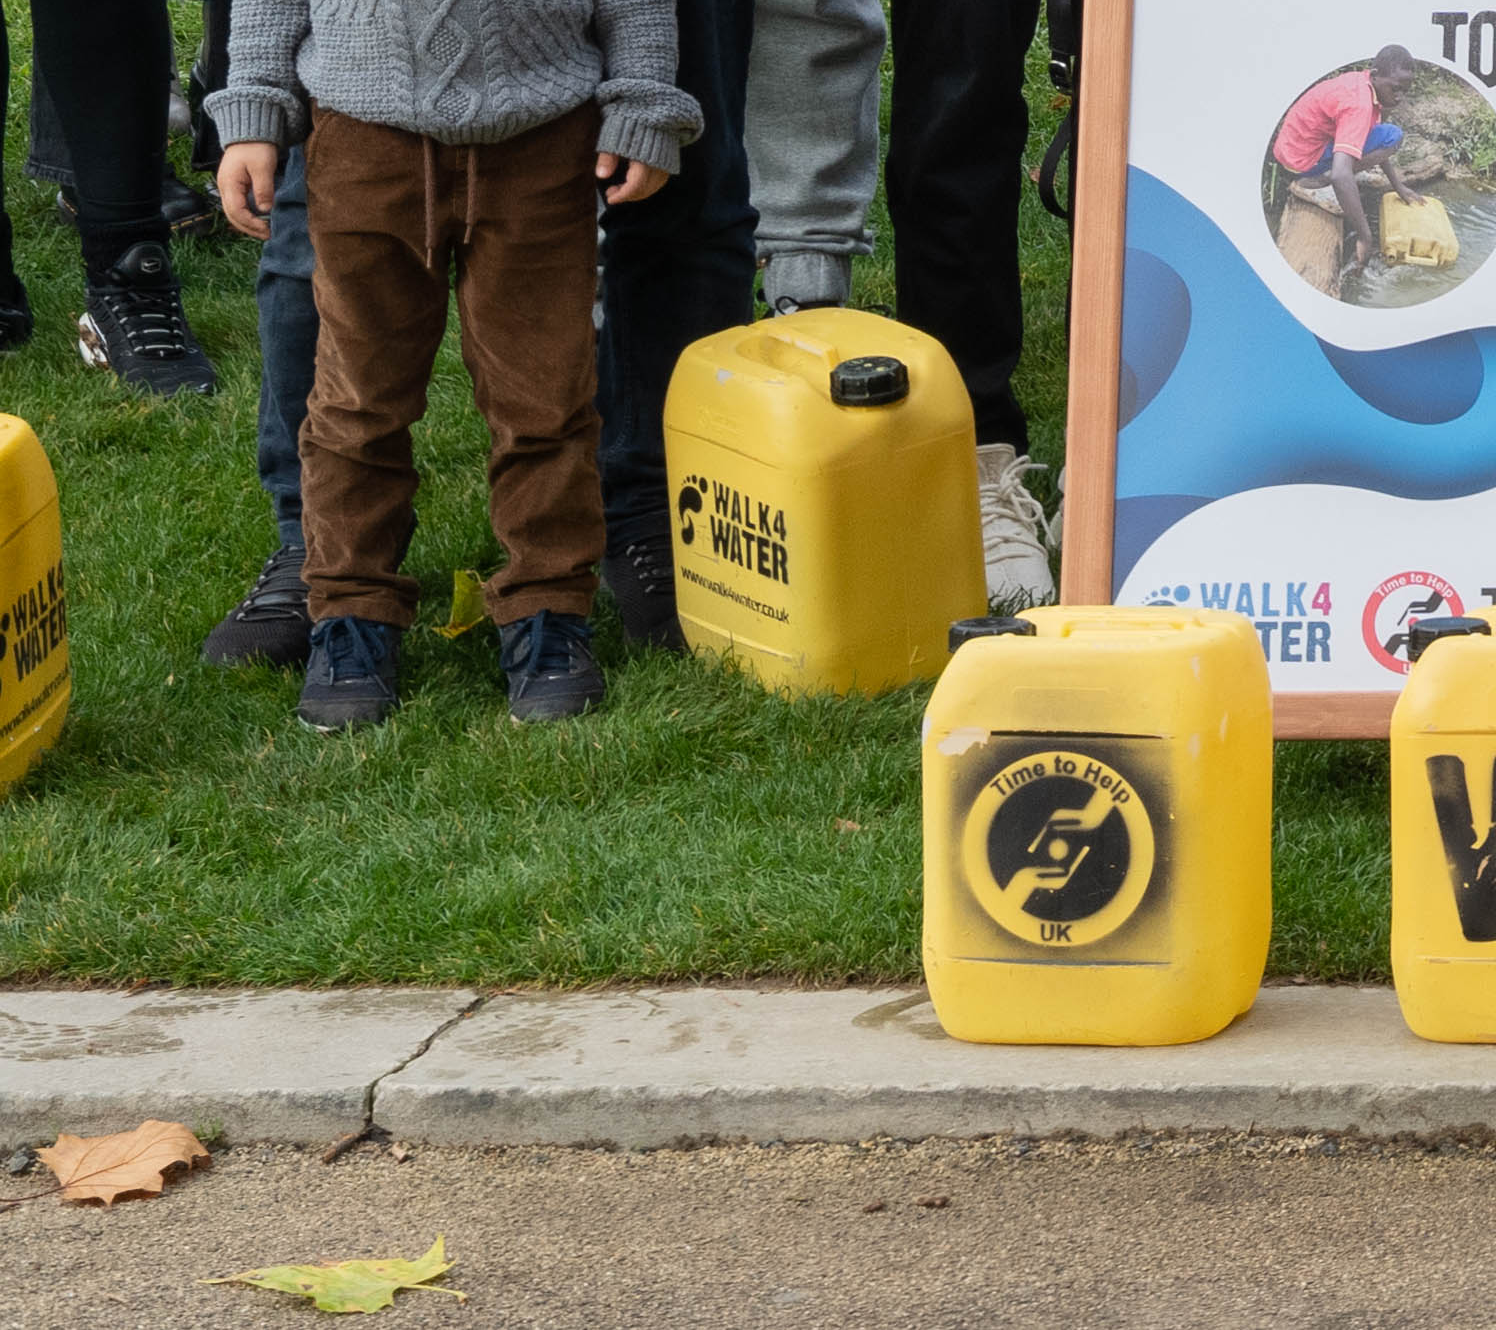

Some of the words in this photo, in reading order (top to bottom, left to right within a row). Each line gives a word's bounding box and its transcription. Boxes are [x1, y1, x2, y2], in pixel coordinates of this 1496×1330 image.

[713, 479, 787, 542] WALK4
[709, 513, 789, 585] WATER
[1200, 582, 1333, 618] WALK4
[1377, 576, 1410, 599] Time
[1409, 572, 1425, 584] to
[1424, 574, 1452, 598] Help
[1262, 621, 1333, 664] TER
[989, 761, 1047, 800] Time
[1052, 755, 1078, 776] to
[1082, 763, 1133, 807] Help
[1039, 922, 1073, 944] UK
